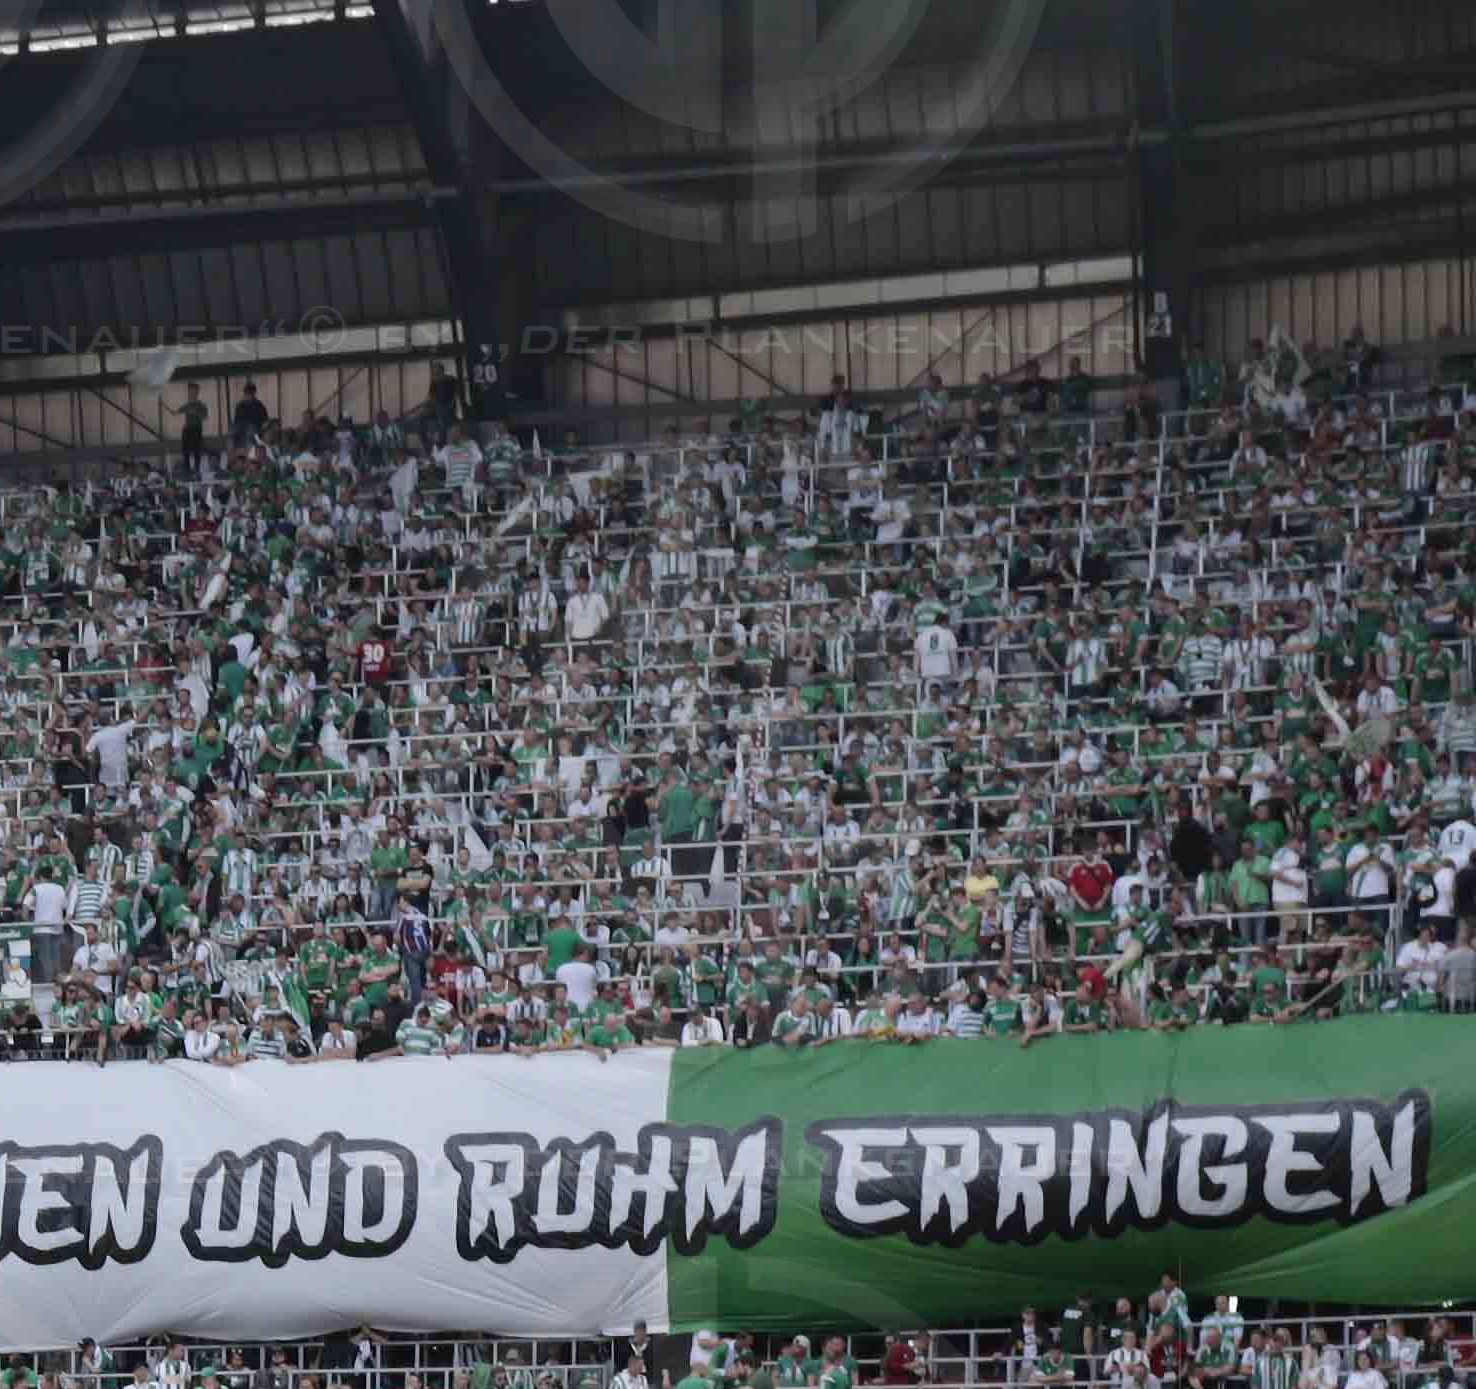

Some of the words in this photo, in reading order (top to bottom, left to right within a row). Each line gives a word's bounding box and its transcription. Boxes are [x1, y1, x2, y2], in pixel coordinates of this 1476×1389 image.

[191, 1138, 411, 1262] UND
[455, 1122, 770, 1257] RUHM
[818, 1094, 1418, 1243] ERRINGEN
